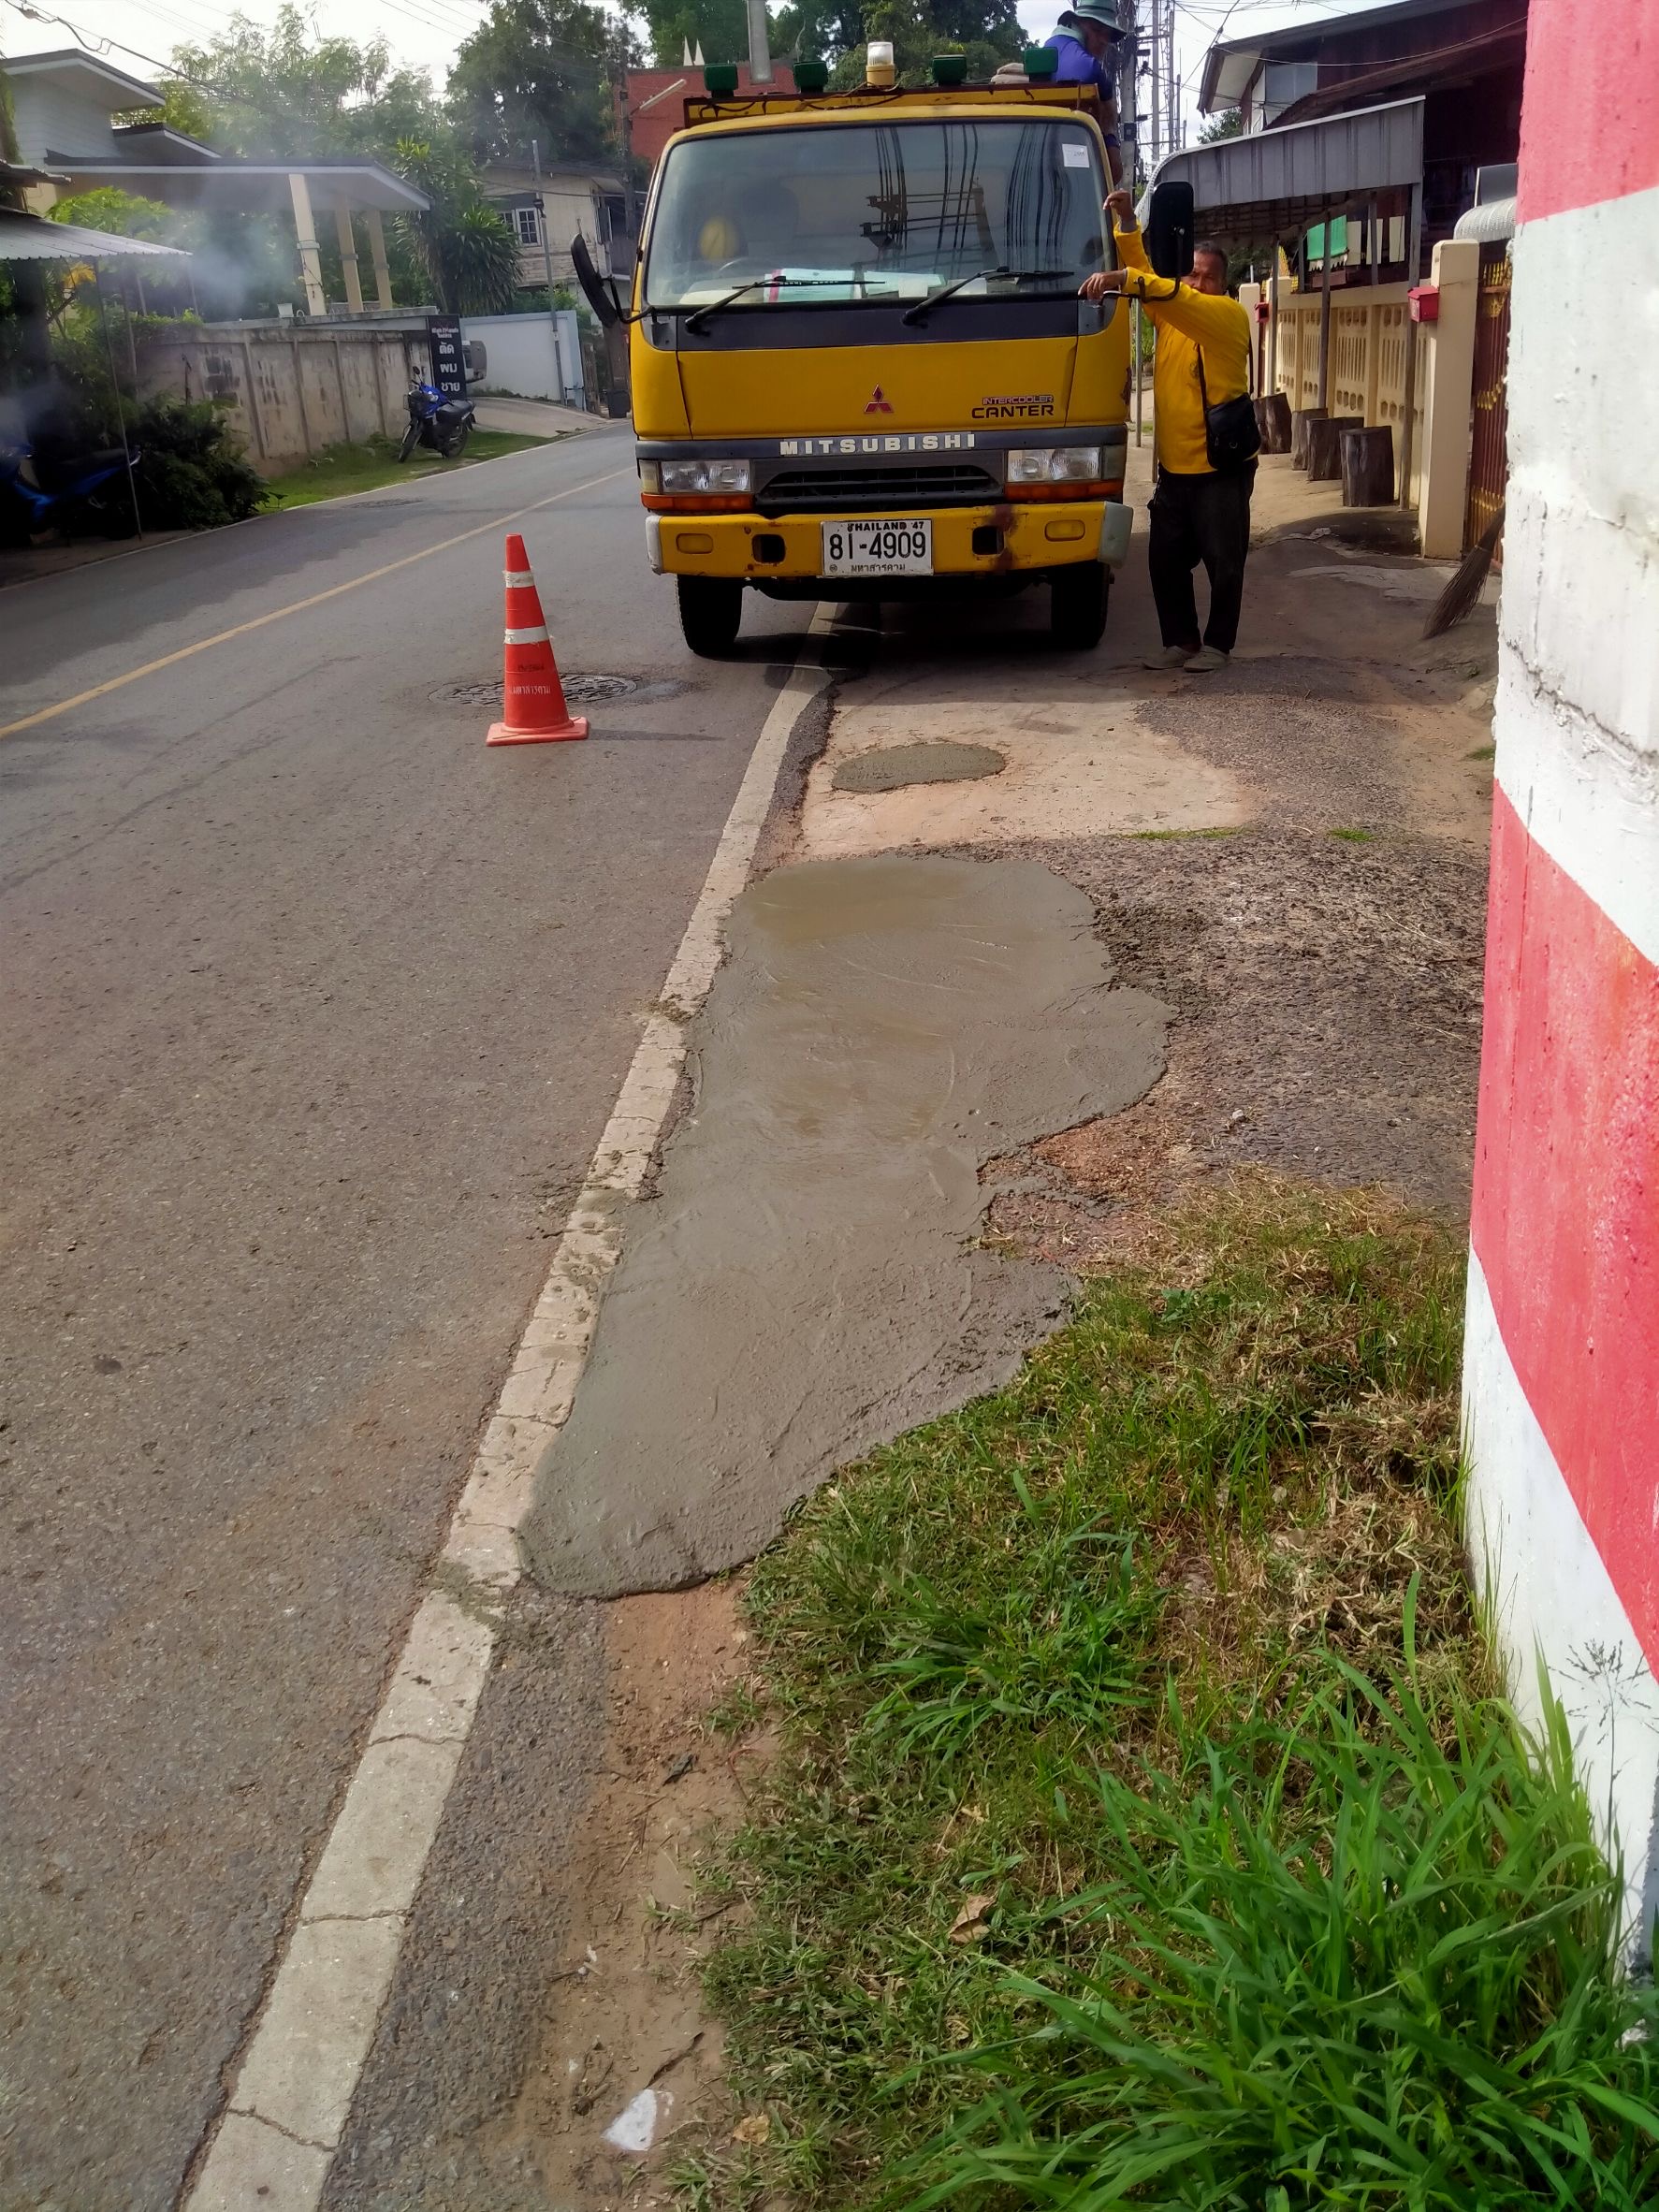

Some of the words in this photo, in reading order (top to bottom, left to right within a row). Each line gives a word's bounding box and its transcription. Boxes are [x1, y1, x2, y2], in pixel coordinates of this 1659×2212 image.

[439, 341, 455, 354] ตัด
[440, 363, 458, 373] ผม
[441, 382, 460, 392] ชาย
[982, 395, 1054, 405] INTERCOOLER
[971, 404, 1055, 419] CANTER
[779, 433, 975, 456] MITSUBISHI
[847, 522, 907, 532] THAILAND
[829, 531, 926, 560] 81-4909
